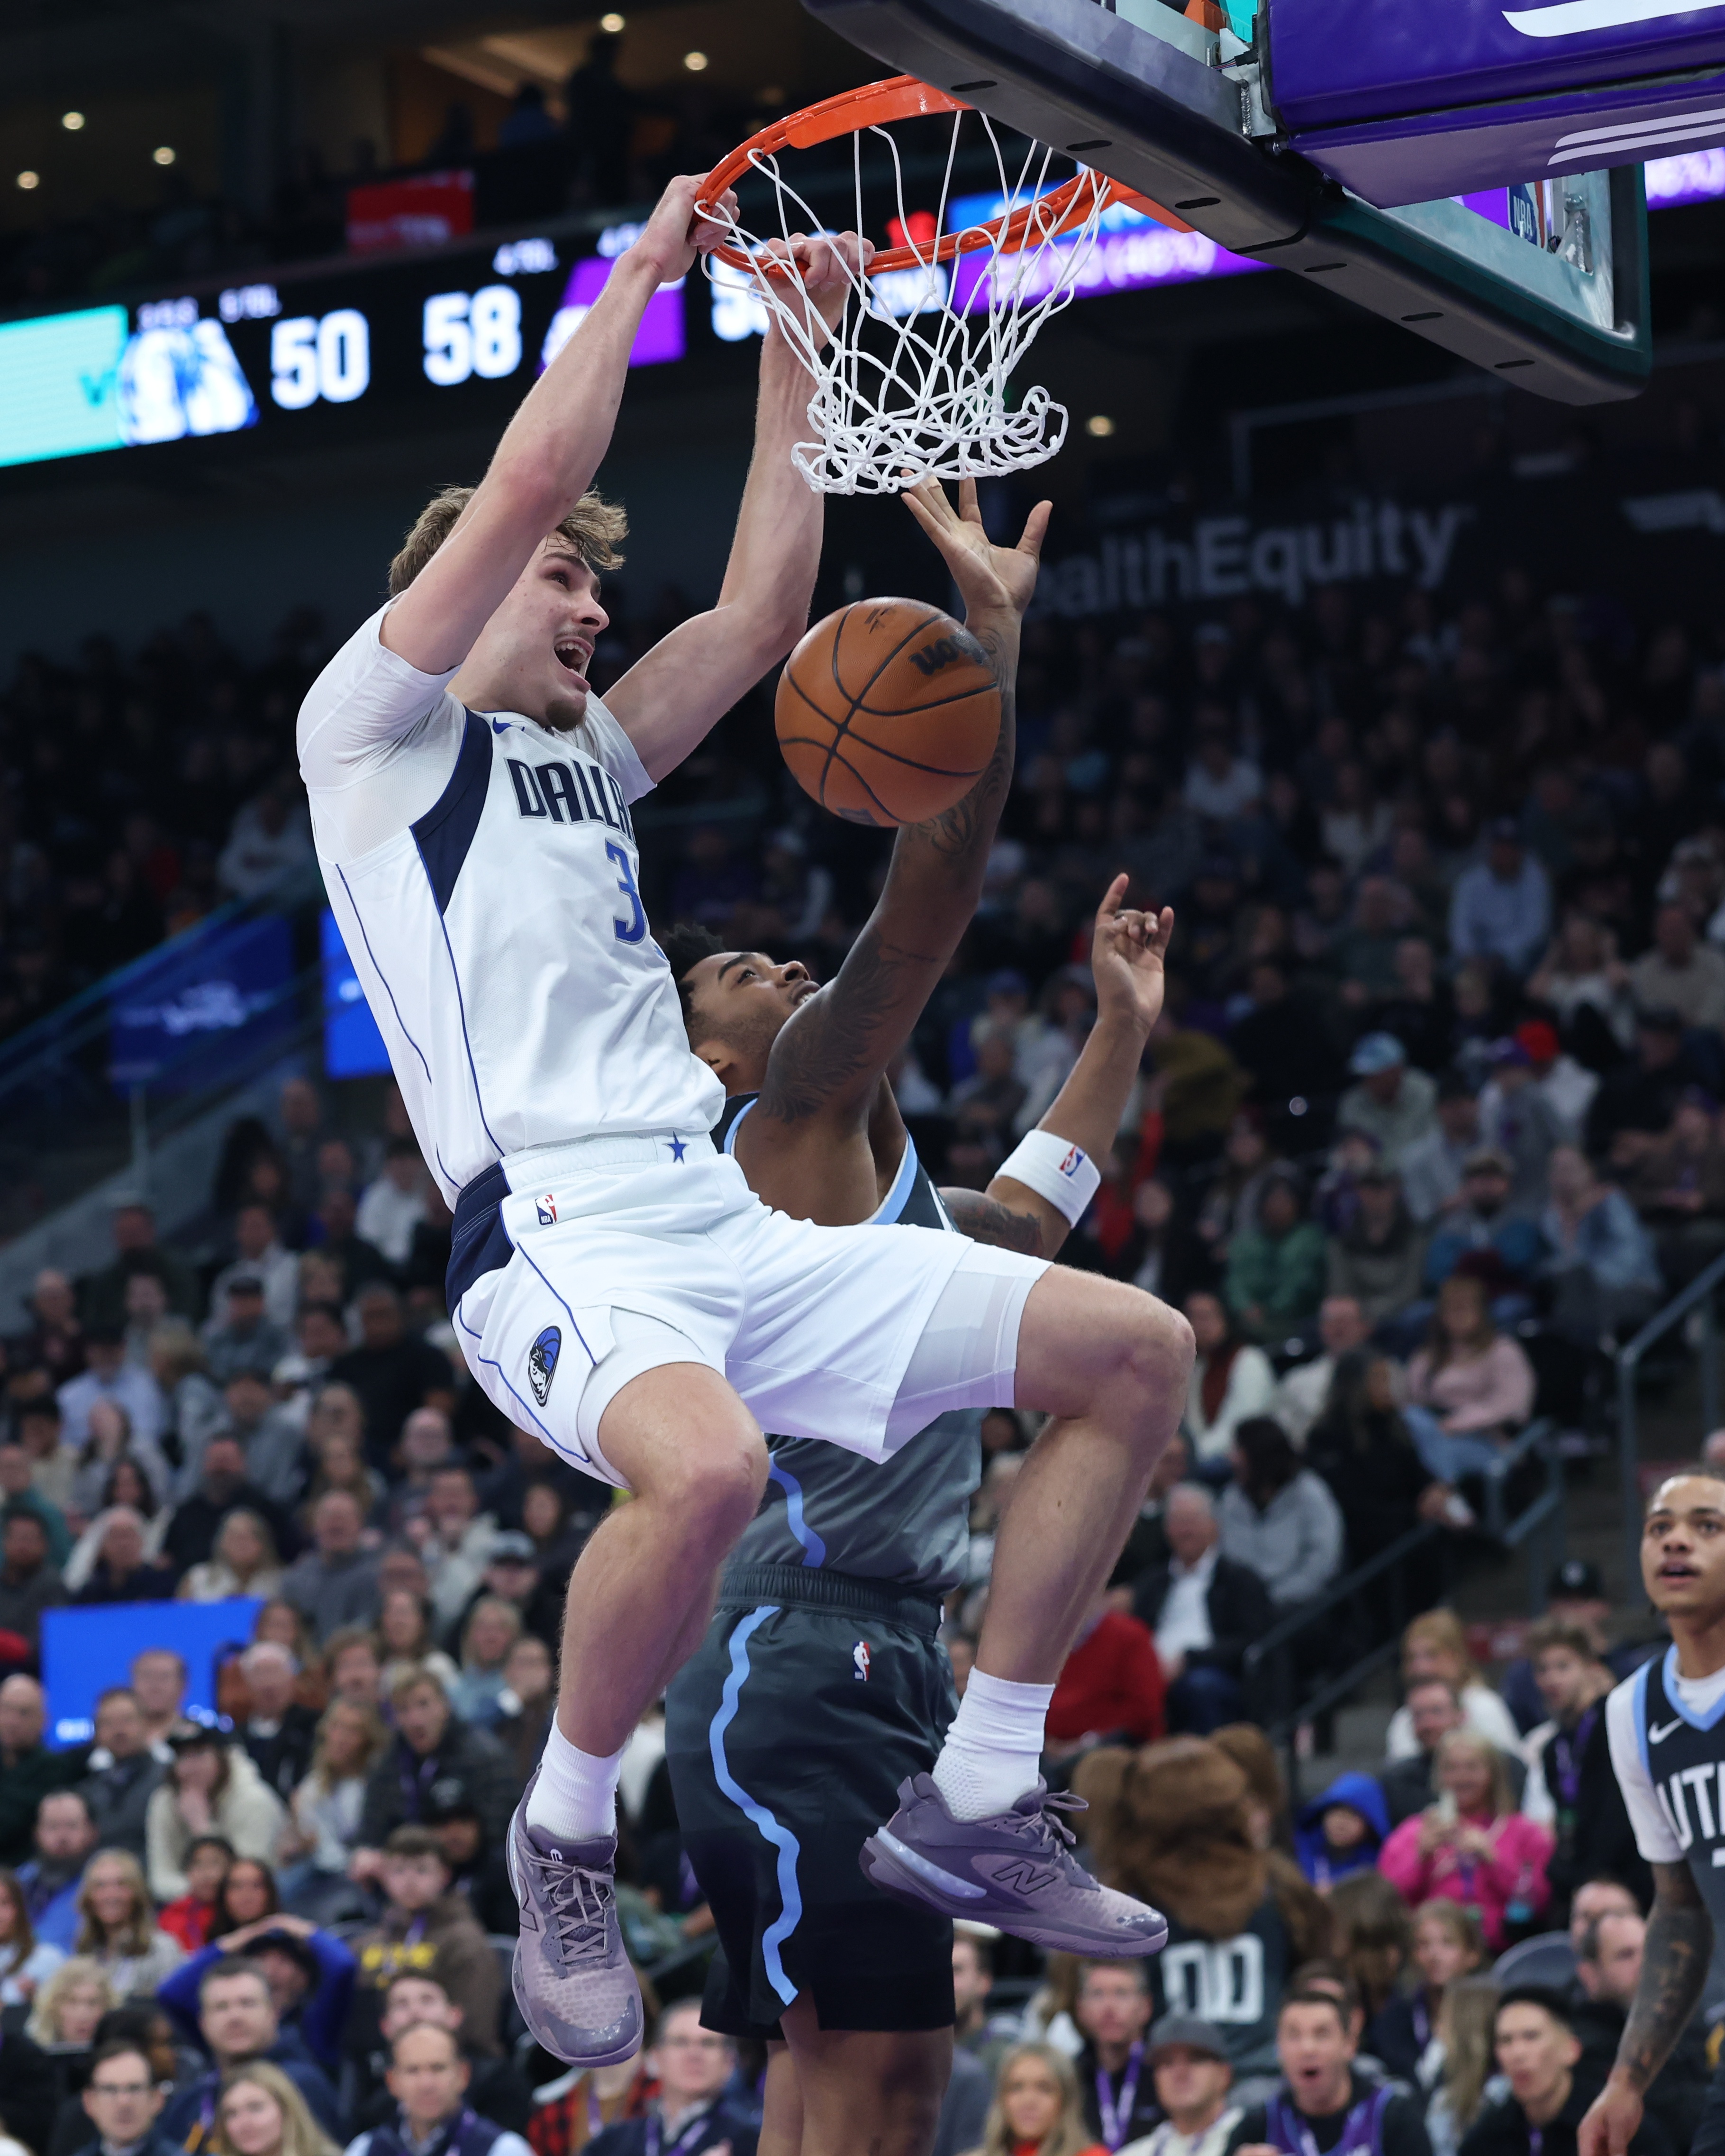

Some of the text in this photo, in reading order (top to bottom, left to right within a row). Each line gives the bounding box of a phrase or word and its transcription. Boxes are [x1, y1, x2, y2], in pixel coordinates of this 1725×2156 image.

[1513, 195, 1533, 237] NBA
[271, 308, 371, 410] 50
[423, 285, 522, 386] 58
[504, 757, 636, 845] DALLA
[541, 1215, 551, 1224] NBA
[1656, 1760, 1725, 1850] UT
